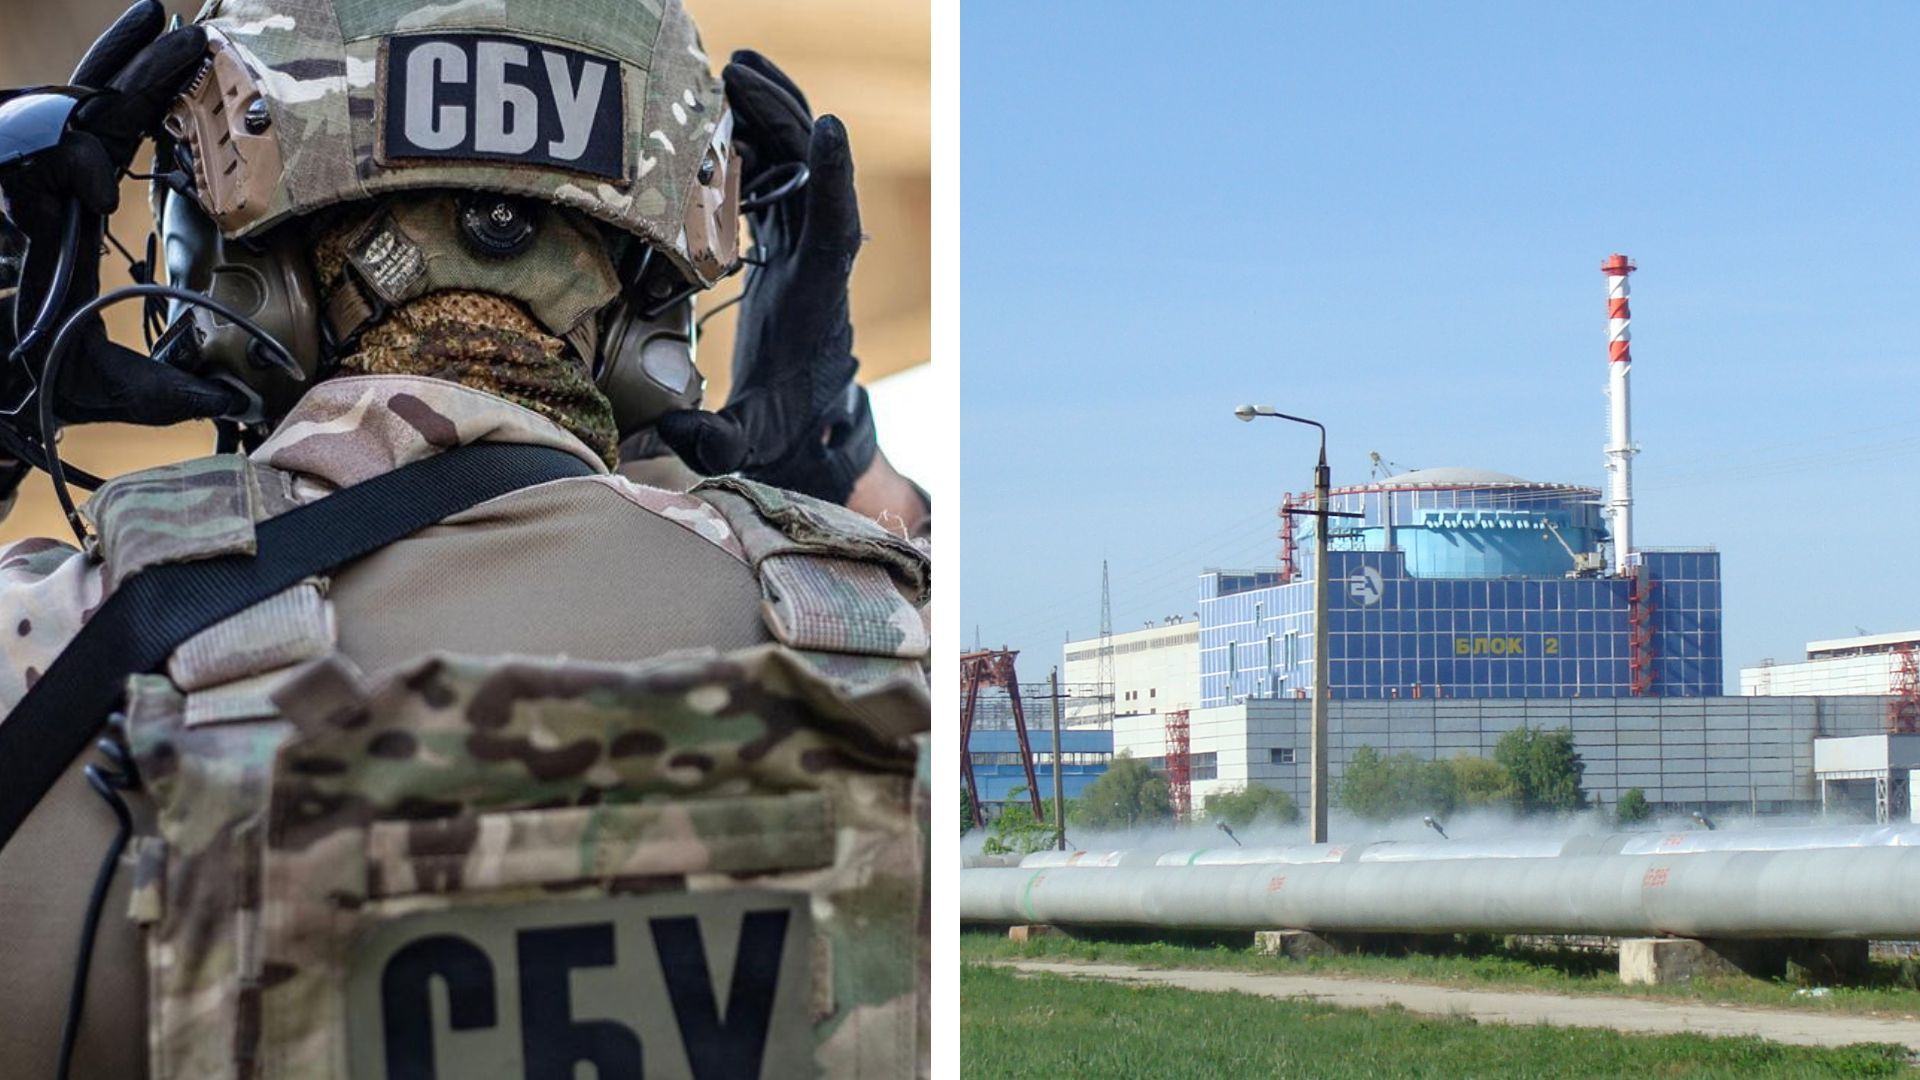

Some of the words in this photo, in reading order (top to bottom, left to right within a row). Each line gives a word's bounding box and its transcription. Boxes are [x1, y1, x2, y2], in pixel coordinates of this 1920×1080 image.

[404, 41, 607, 160] СБУ
[1455, 637, 1523, 655] БЛОК
[1545, 637, 1559, 655] 2
